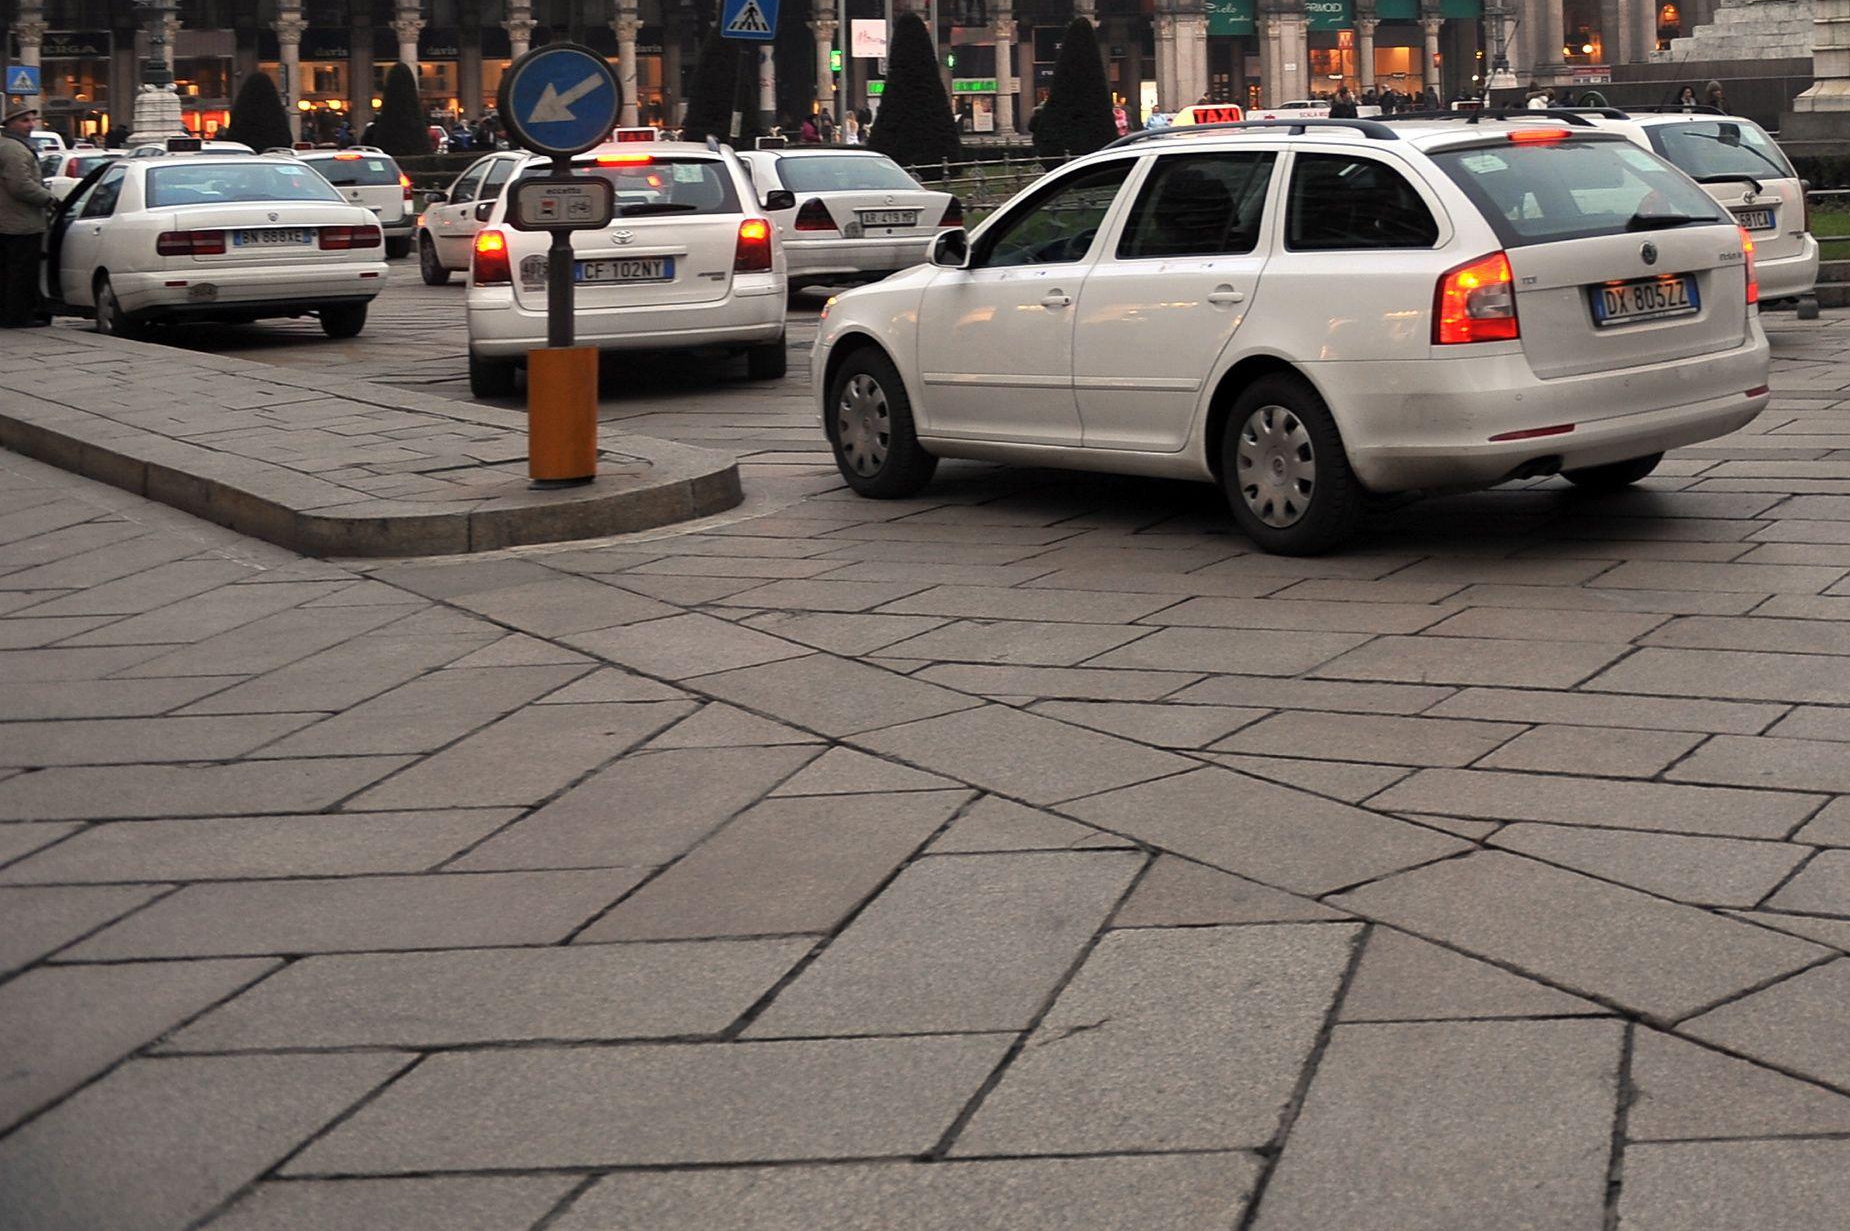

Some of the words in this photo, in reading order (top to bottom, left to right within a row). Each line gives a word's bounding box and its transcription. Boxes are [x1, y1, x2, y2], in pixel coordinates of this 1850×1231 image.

[1193, 109, 1239, 124] TAXI
[618, 131, 654, 142] TAXI
[584, 263, 604, 279] CF
[612, 260, 662, 278] 102NY
[1604, 289, 1629, 315] DX
[1633, 280, 1688, 311] 805ZZ
